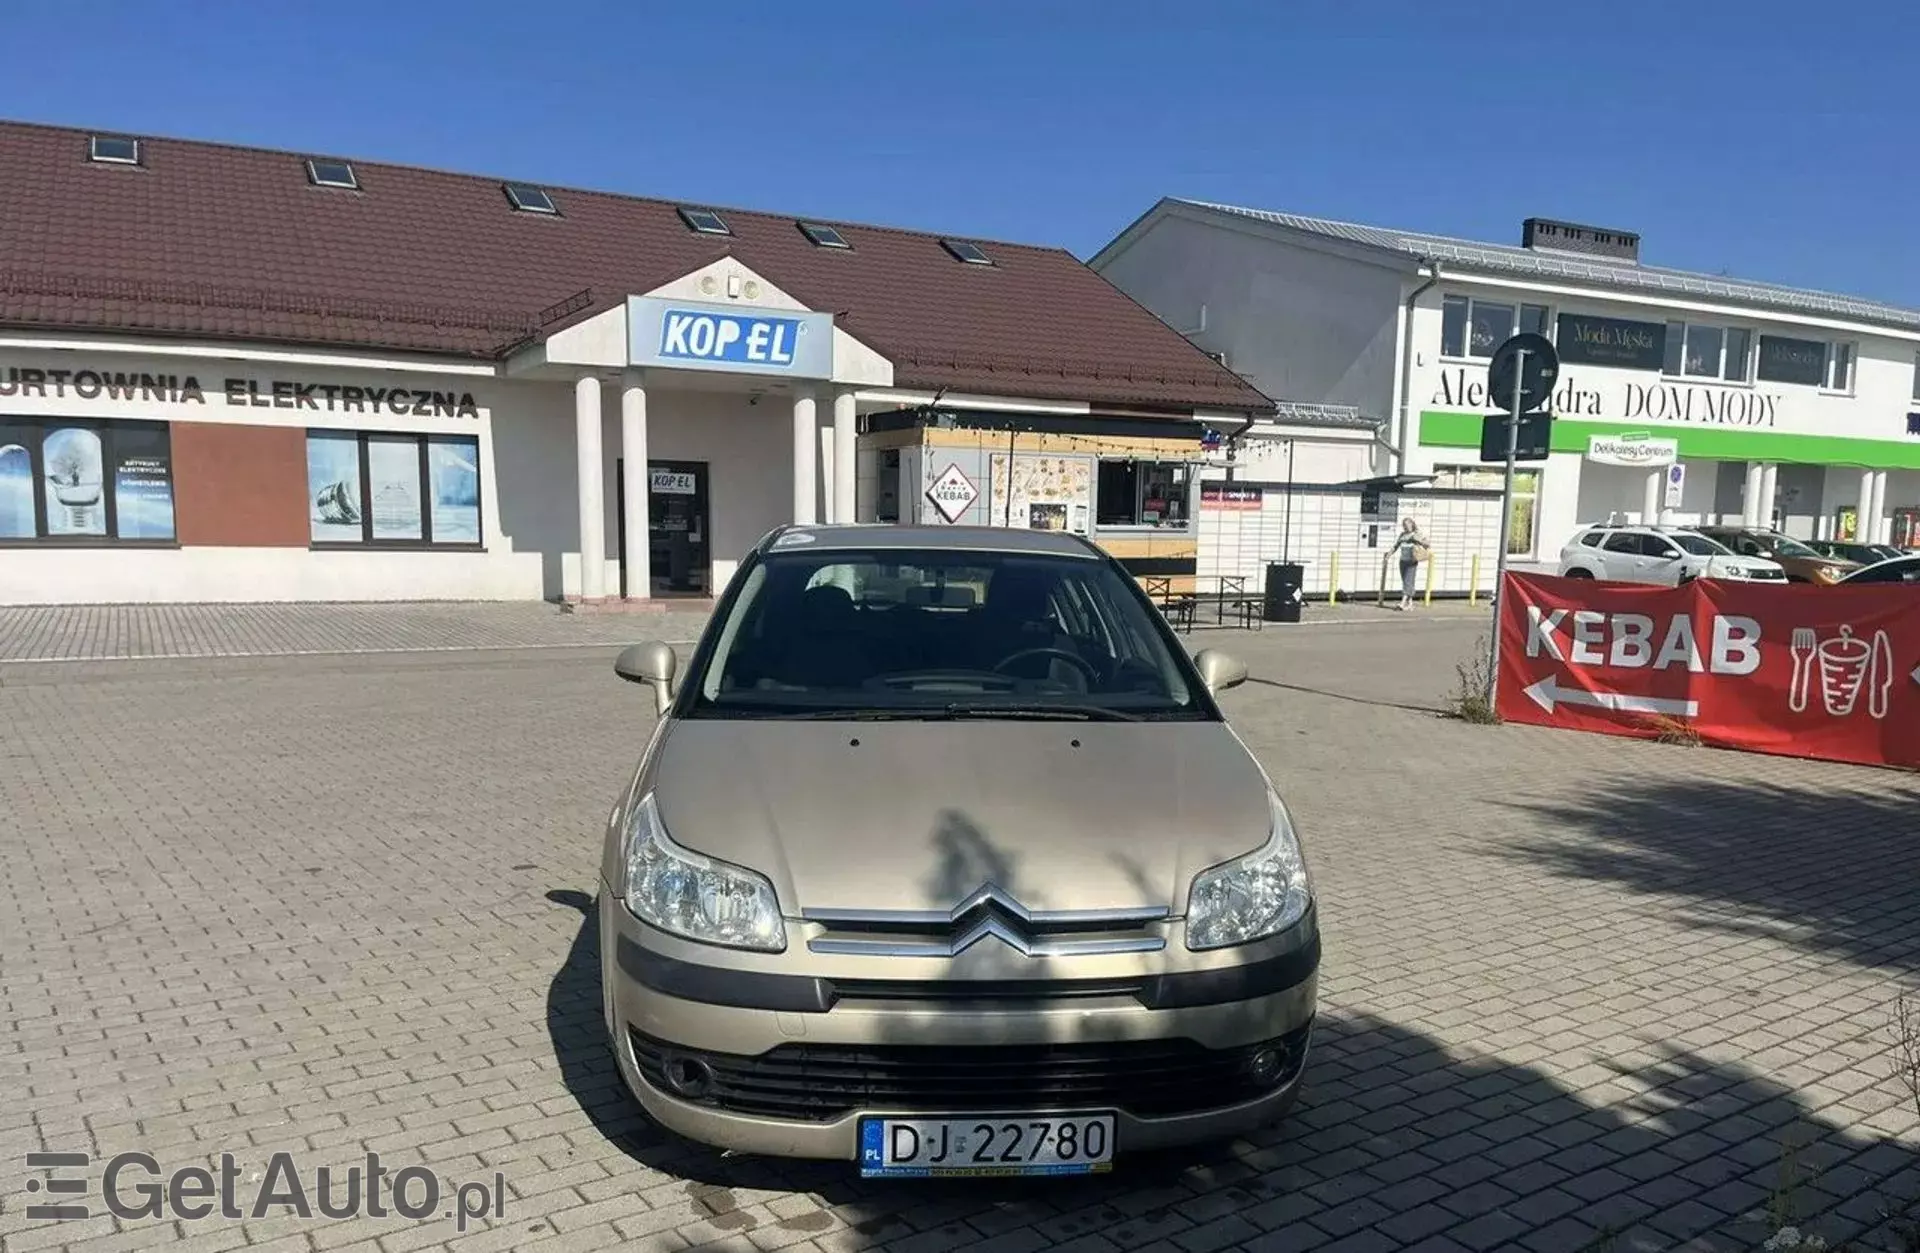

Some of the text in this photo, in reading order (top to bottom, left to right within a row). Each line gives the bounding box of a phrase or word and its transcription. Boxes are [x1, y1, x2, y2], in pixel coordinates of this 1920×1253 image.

[664, 314, 791, 362] KOP EL
[0, 366, 479, 419] URTOWNIA ELEKTRYCZNA
[1431, 367, 1783, 427] Aledra DOM MODY
[936, 489, 971, 501] KEBAB
[1525, 605, 1762, 676] KEBAB
[865, 1149, 881, 1161] PL
[972, 1120, 1106, 1163] 22780
